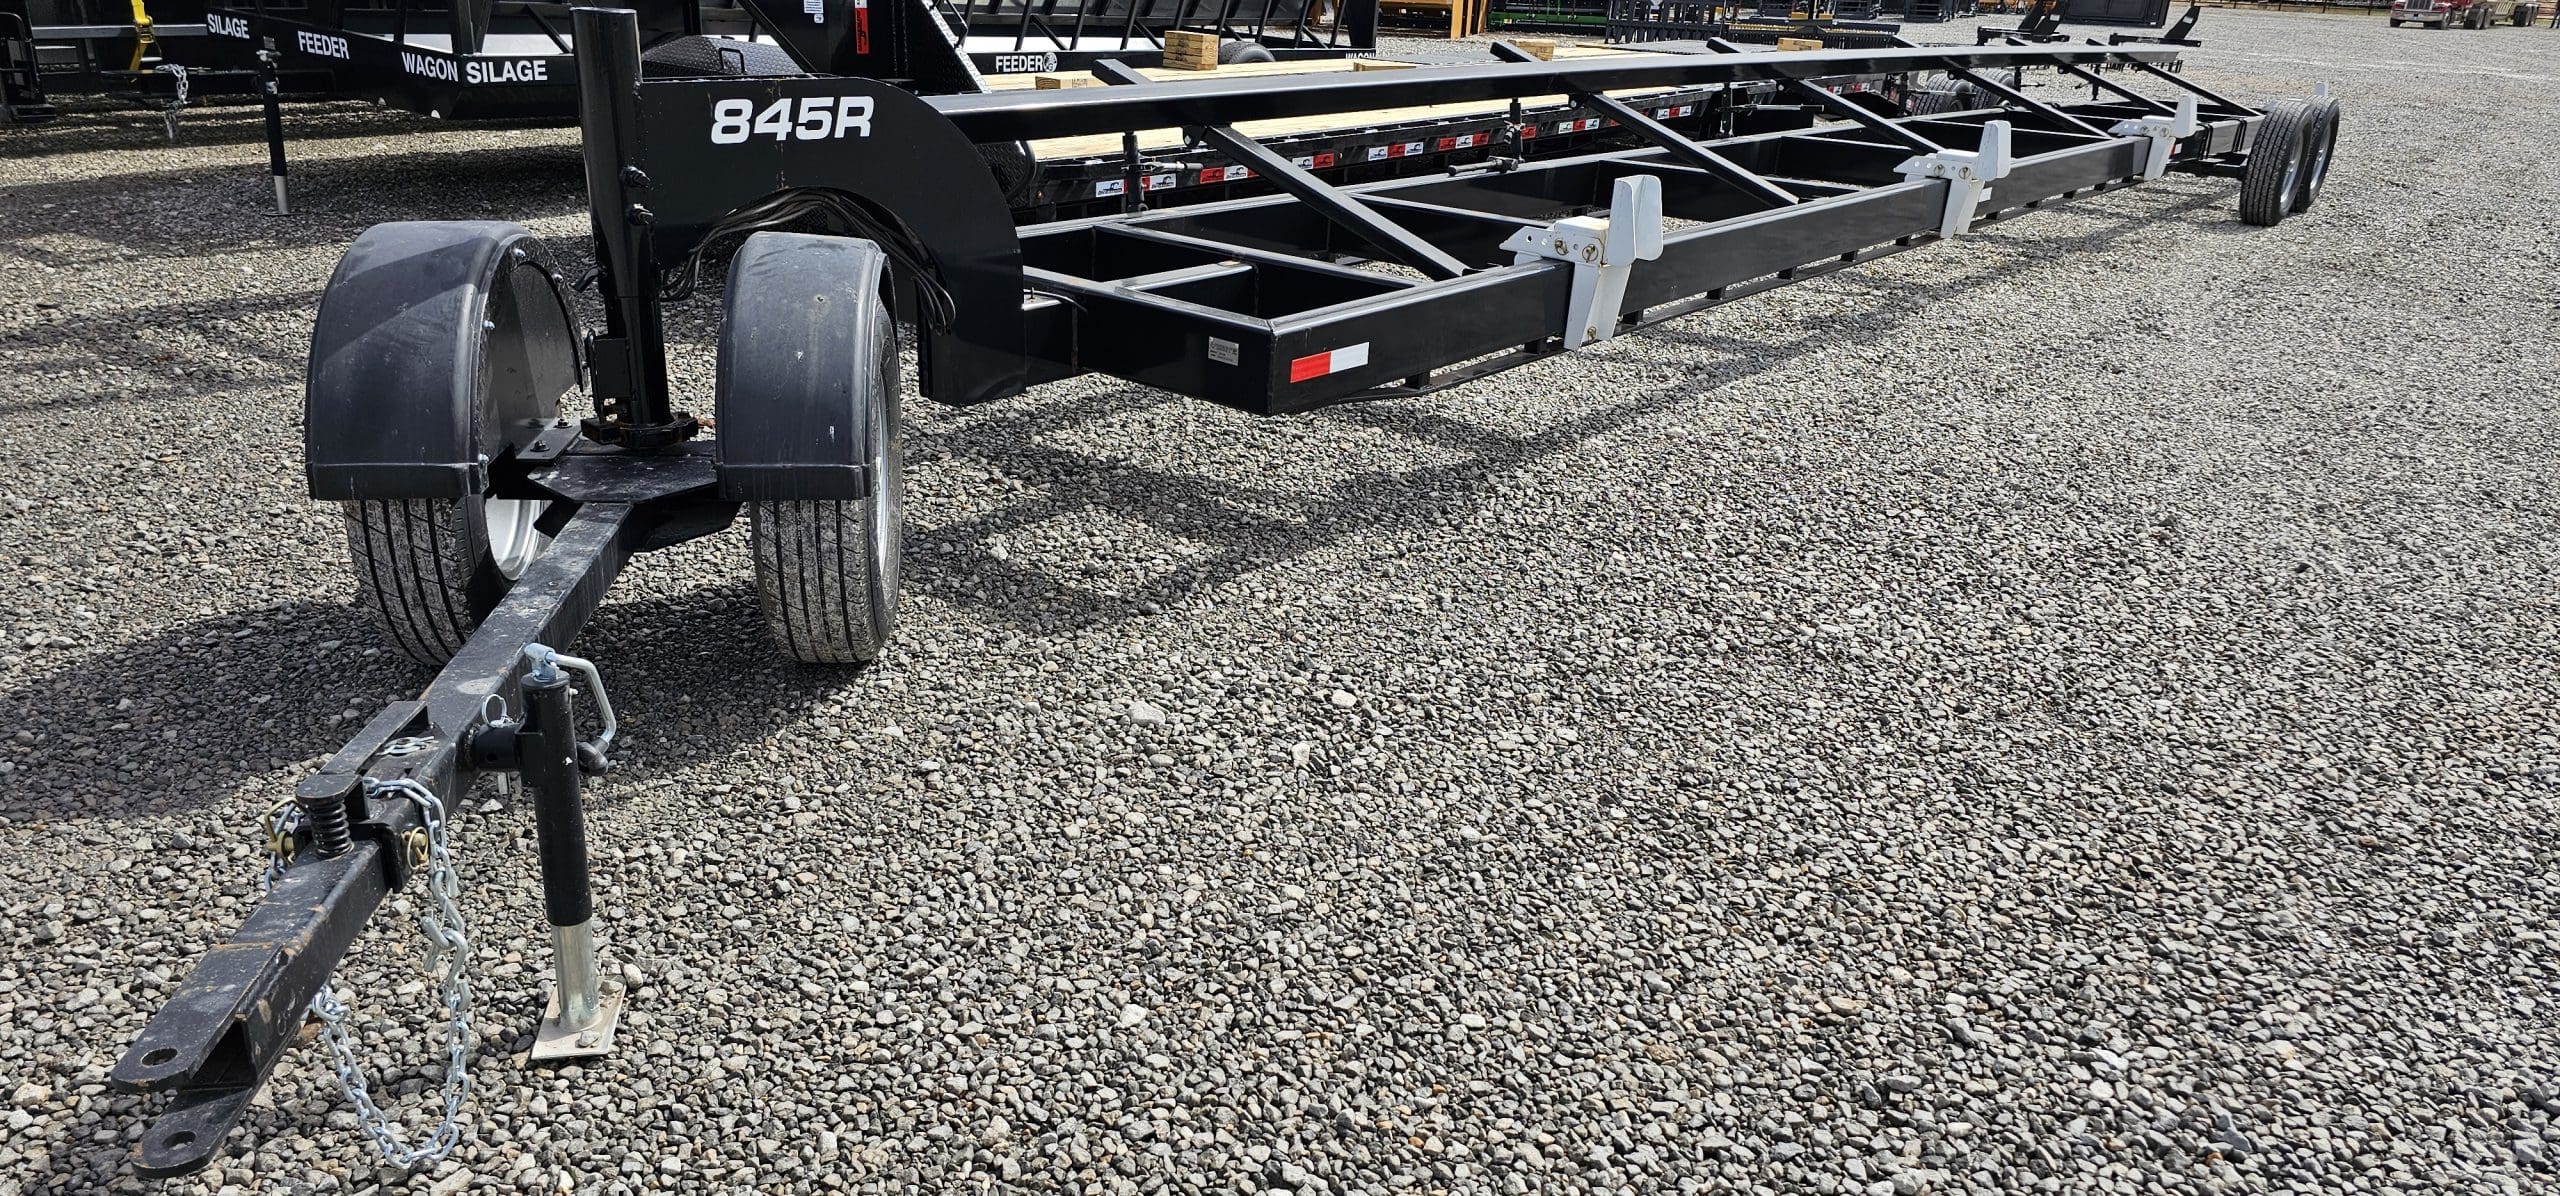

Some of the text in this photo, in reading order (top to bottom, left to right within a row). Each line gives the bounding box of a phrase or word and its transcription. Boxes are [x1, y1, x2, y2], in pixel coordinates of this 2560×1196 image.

[207, 13, 459, 82] SILAGE FEEDER WAGON
[995, 55, 1043, 73] FEEDER
[466, 59, 548, 84] SILAGE
[710, 96, 875, 145] 845R
